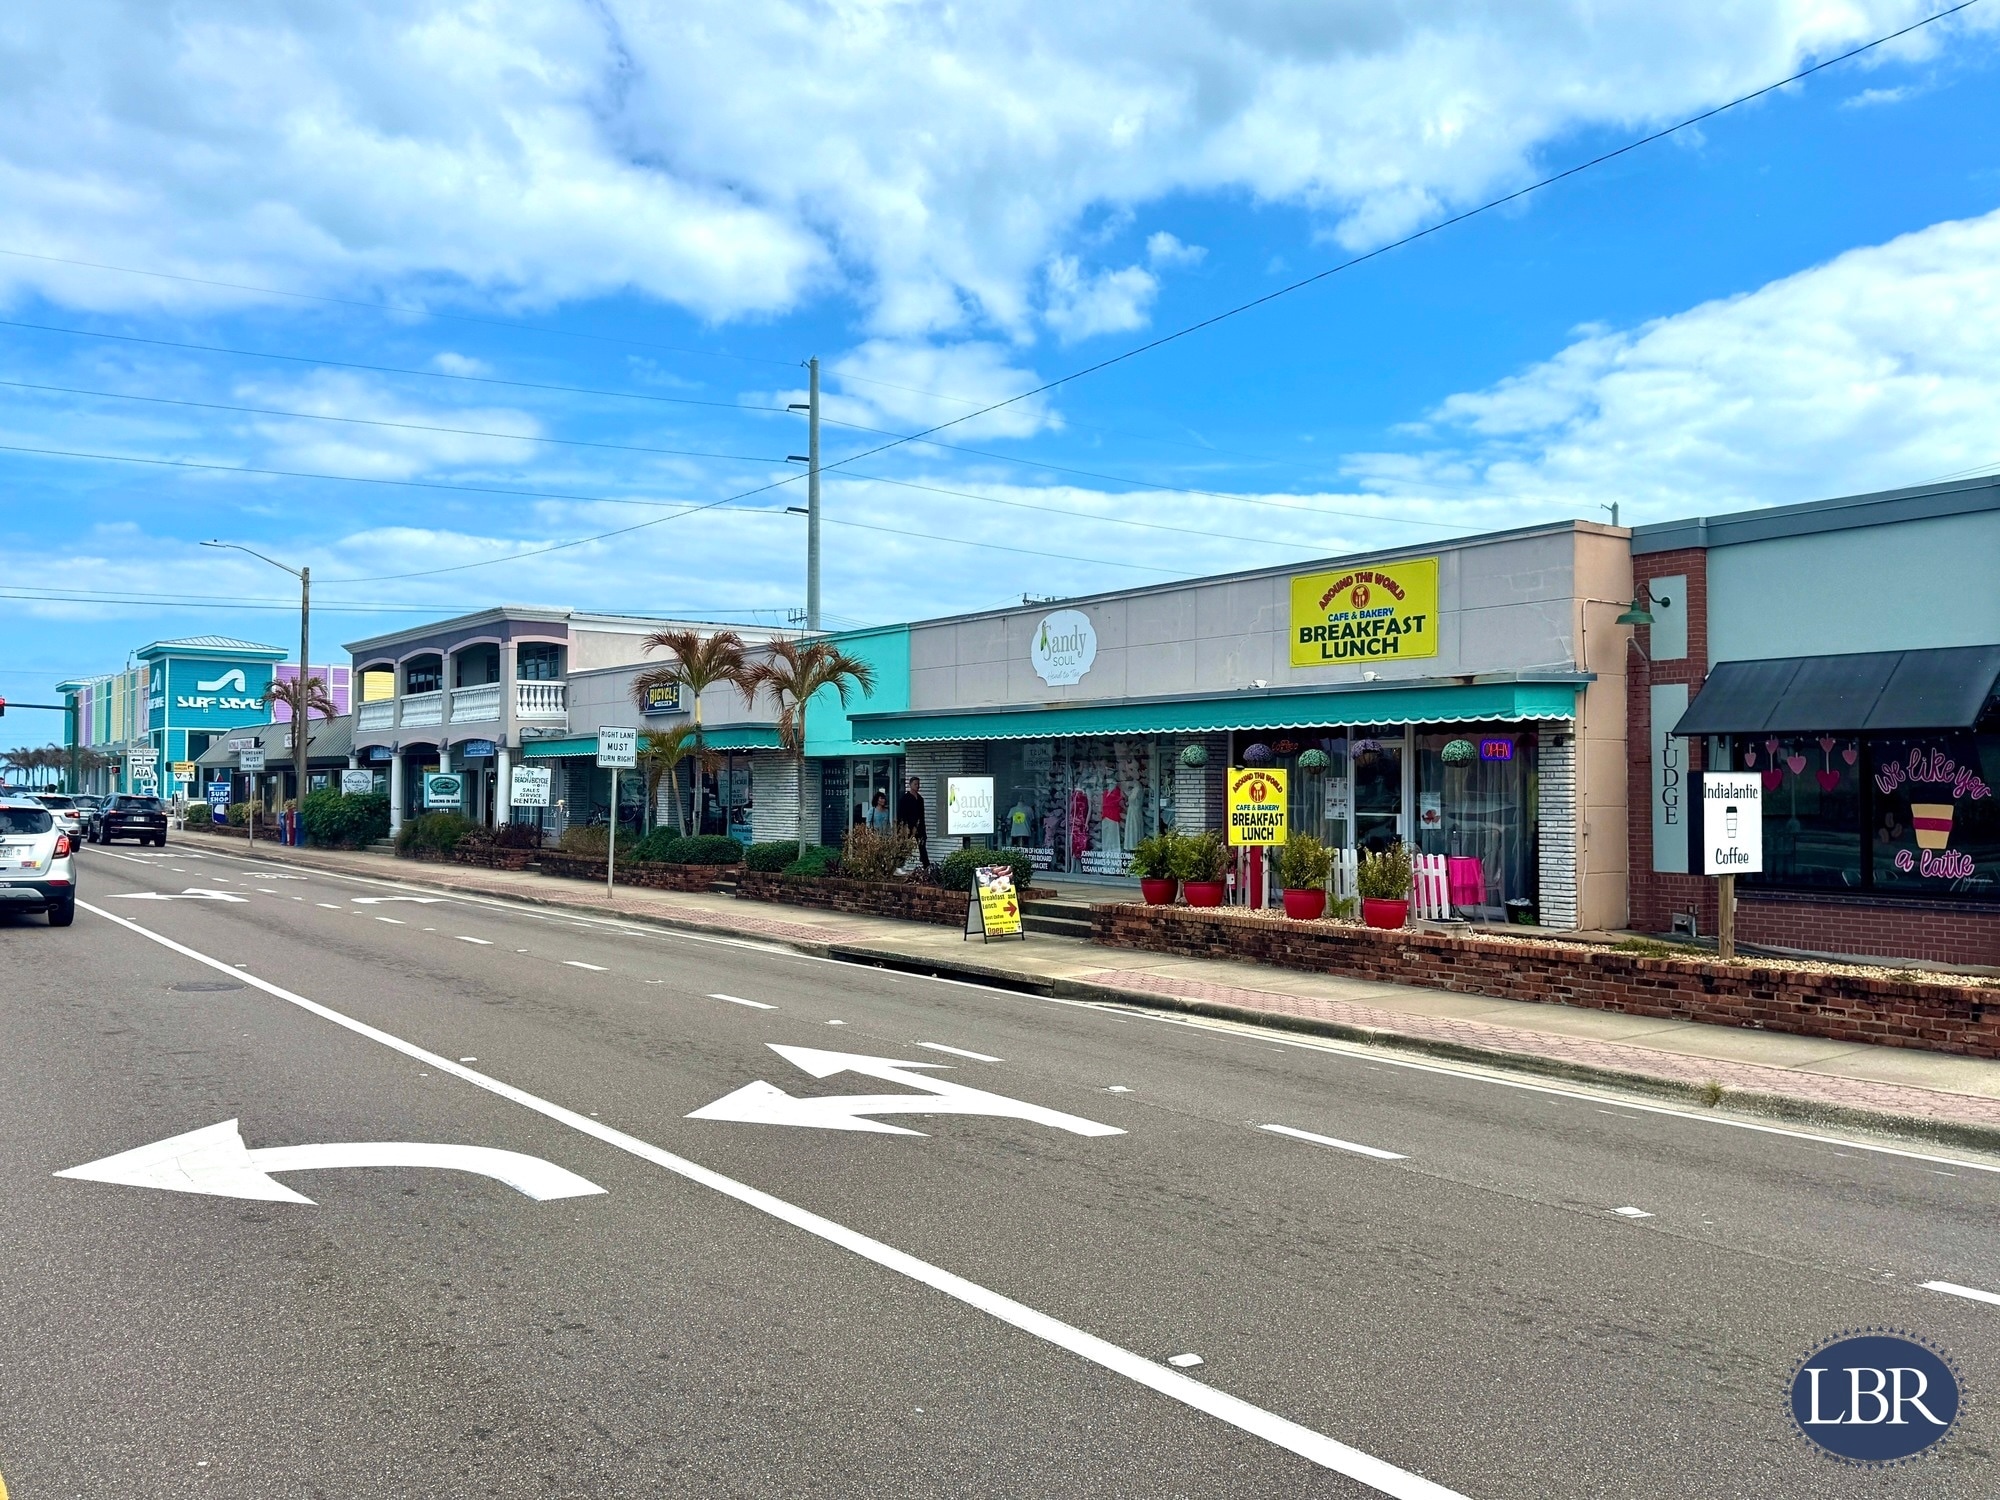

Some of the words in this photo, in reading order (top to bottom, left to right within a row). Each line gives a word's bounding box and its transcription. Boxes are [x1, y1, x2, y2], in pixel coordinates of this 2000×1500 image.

[1319, 575, 1354, 611] AROUND
[1354, 571, 1374, 584] THE
[1374, 573, 1406, 601] WORLD
[1327, 612, 1350, 623] CAFE
[1351, 611, 1358, 620] &
[1359, 607, 1395, 618] BAKERY
[1299, 615, 1426, 644] BREAKFAST
[1321, 637, 1399, 660] LUNCH
[1053, 656, 1075, 667] SOUL
[177, 695, 217, 709] SURF
[650, 686, 679, 705] BICYCLE
[601, 730, 619, 739] RIGHT
[620, 731, 635, 740] LANE
[607, 743, 629, 752] MUST
[1482, 742, 1510, 758] OPEN
[600, 754, 616, 762] TURN
[617, 755, 635, 763] RIGHT
[1233, 773, 1253, 793] AROUND
[1265, 774, 1283, 793] WORLD
[1662, 732, 1679, 825] FUDGE
[1703, 782, 1758, 799] Indialantic
[962, 810, 983, 818] SOUL
[1232, 812, 1284, 826] BREAKFAST
[1242, 827, 1274, 841] LUNCH
[1715, 847, 1749, 865] Coffee
[1894, 849, 1914, 872] a
[1920, 849, 1975, 878] latte
[983, 902, 998, 910] Lunch
